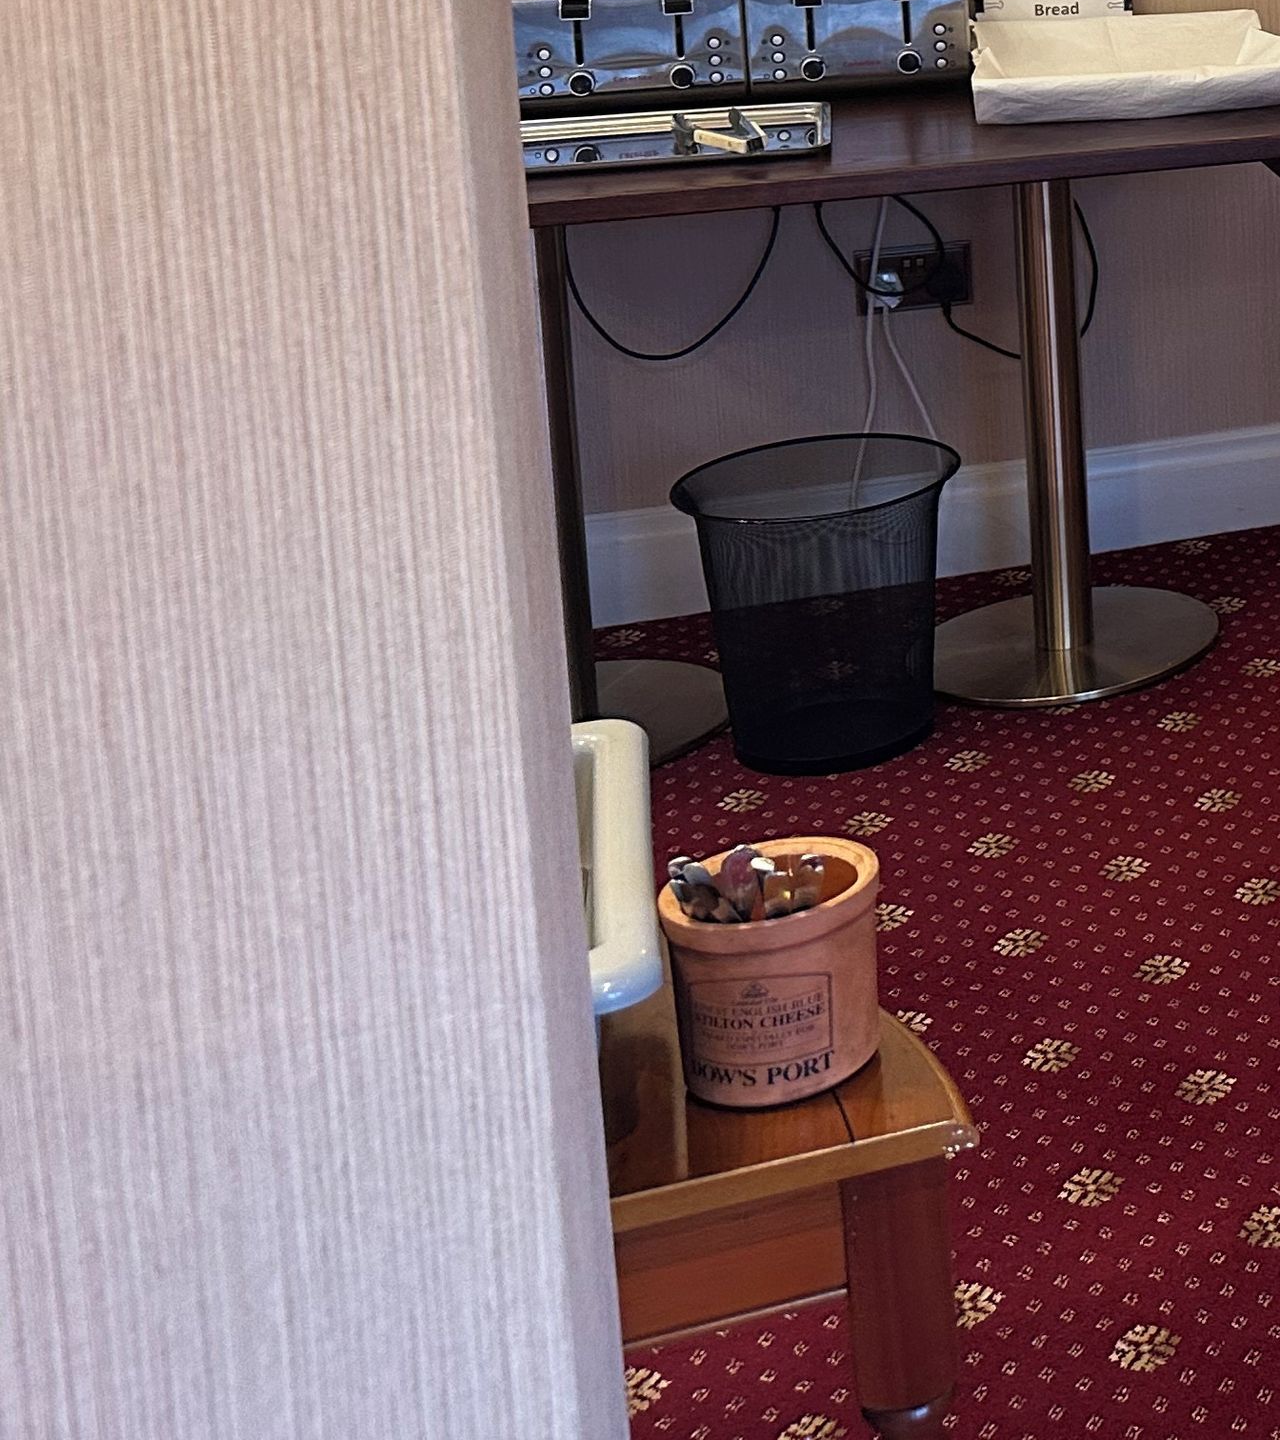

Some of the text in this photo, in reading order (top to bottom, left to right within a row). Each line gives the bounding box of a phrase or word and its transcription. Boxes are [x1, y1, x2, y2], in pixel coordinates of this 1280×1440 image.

[1035, 2, 1079, 16] Bread
[760, 1003, 826, 1028] CHEESE
[767, 1049, 834, 1086] PORT
